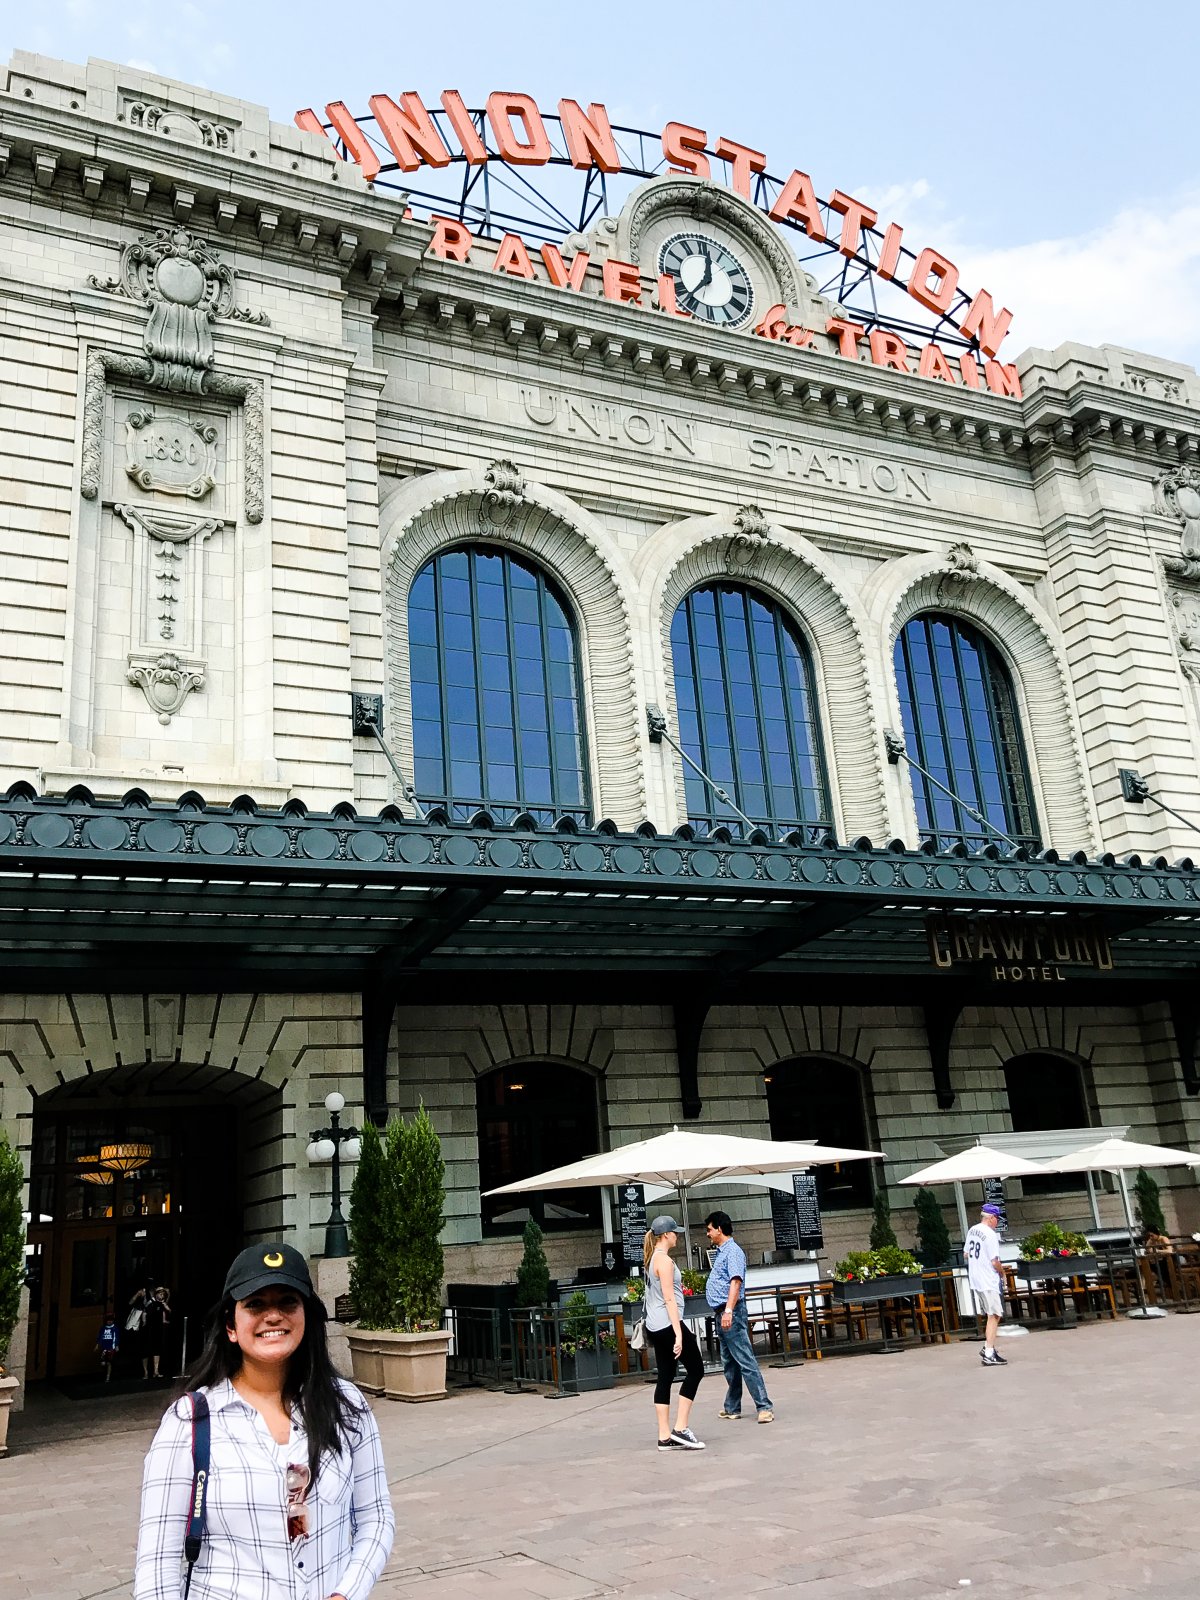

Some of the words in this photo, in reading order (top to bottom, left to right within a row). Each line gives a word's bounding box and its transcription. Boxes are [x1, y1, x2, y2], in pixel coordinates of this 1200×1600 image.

[294, 88, 622, 182] UNION
[661, 121, 1014, 359] STATION
[404, 208, 693, 318] RAVEL
[826, 317, 1023, 398] TRAIN
[520, 389, 697, 456] UNION
[748, 439, 931, 502] STATION
[924, 915, 1114, 970] CRAWFORD
[994, 966, 1066, 981] HOTEL
[969, 1240, 981, 1260] 28
[193, 1470, 206, 1518] Canon
